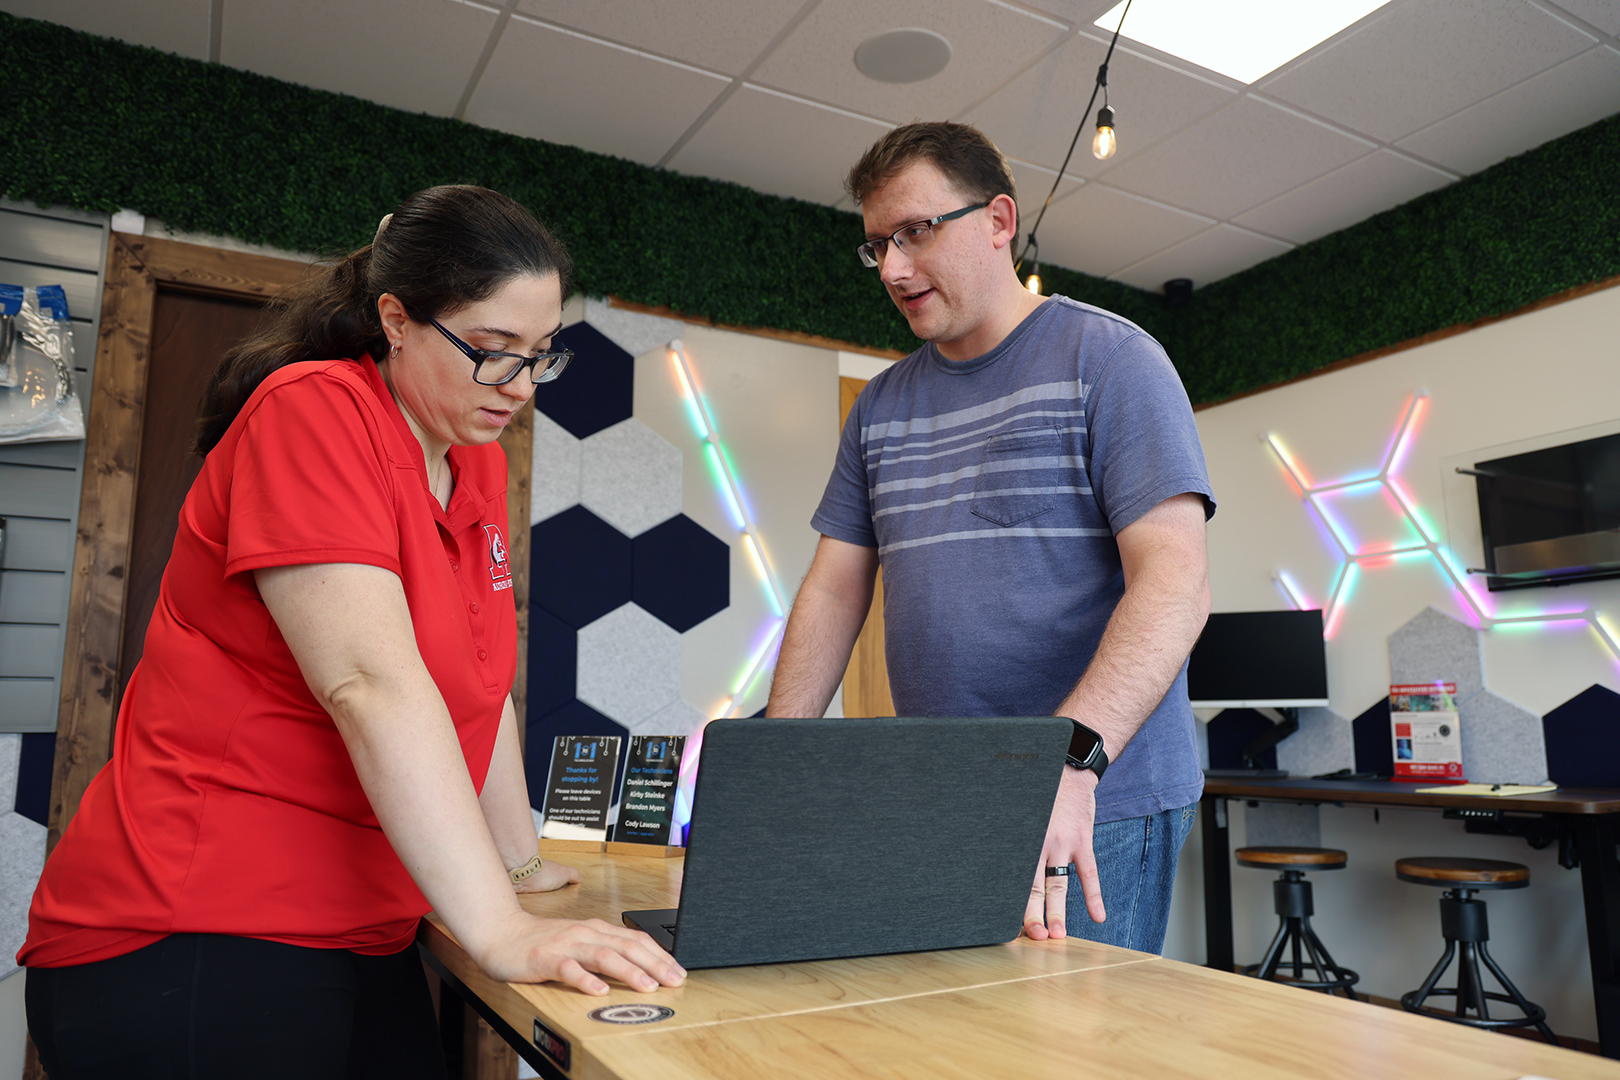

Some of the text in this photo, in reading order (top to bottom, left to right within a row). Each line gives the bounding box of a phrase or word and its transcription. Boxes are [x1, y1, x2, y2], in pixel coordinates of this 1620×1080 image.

[641, 767, 673, 775] Technicians
[561, 776, 599, 784] stopping by!
[627, 778, 673, 788] Daniel Schillinger
[629, 791, 665, 799] Kirby Steinke
[625, 803, 665, 812] Brandon Myers
[625, 820, 660, 829] Cody Lawson
